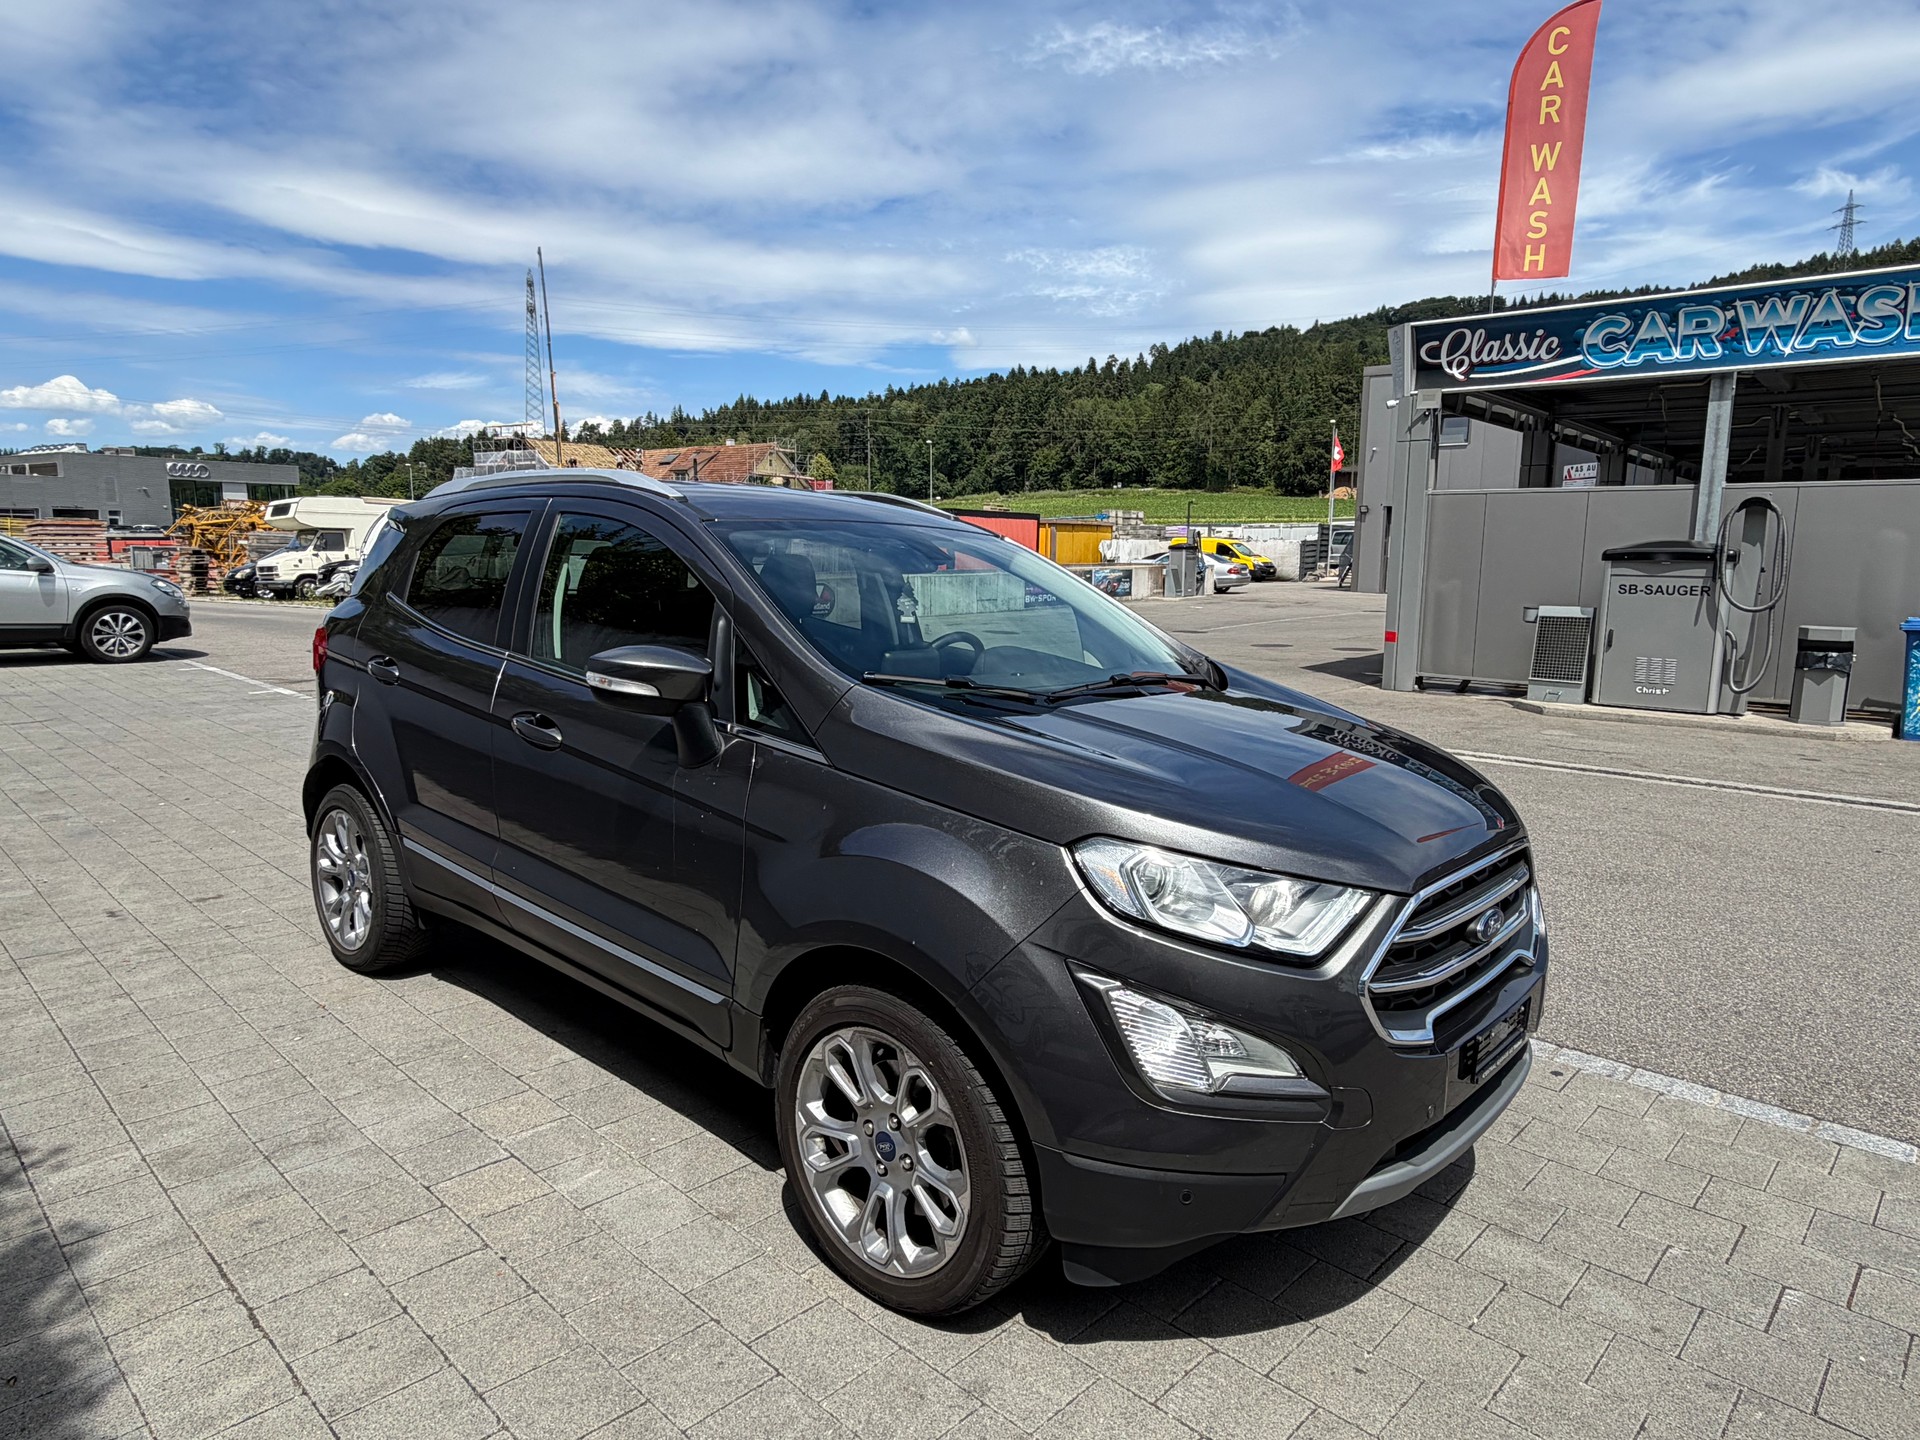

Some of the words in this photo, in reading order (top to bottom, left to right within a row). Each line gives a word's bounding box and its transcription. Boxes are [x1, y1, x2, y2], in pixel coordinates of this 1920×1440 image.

[1538, 26, 1571, 125] CAR
[1523, 141, 1562, 272] WASH
[1420, 327, 1561, 380] Classic
[1582, 304, 1728, 369] CAR
[1734, 282, 1920, 357] WAS
[1617, 583, 1712, 597] SB-SAUGER
